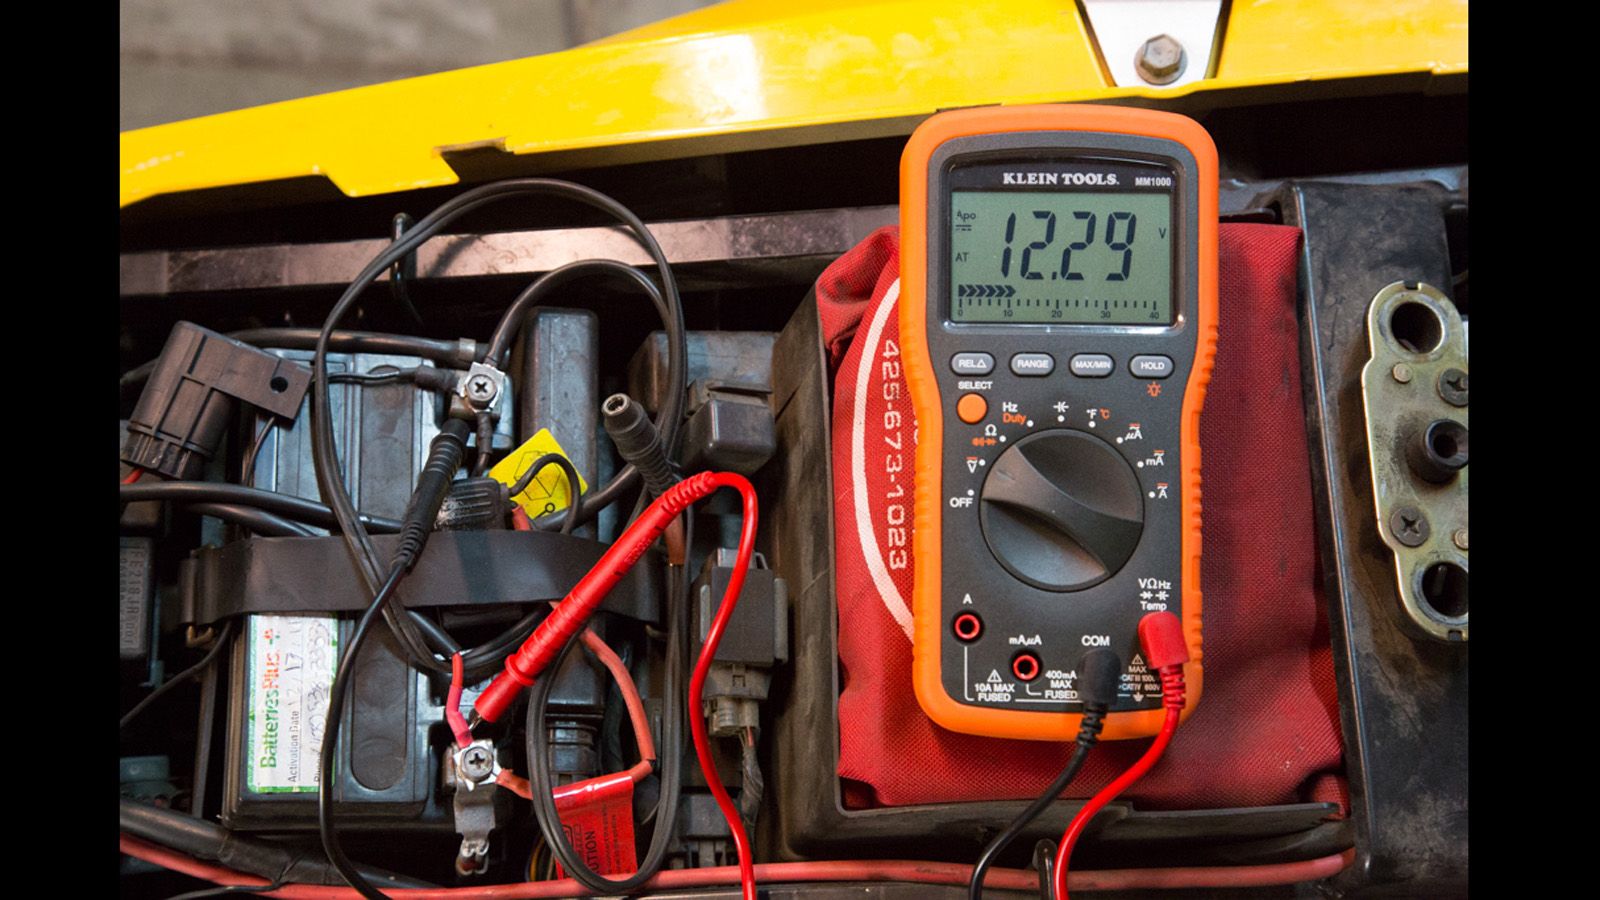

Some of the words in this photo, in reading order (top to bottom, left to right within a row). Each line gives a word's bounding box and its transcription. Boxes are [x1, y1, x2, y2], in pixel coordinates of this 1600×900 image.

[1003, 173, 1058, 185] KLEIN
[1135, 177, 1171, 187] MM1000
[1158, 228, 1167, 239] V
[1001, 211, 1137, 281] 12.29
[955, 253, 969, 263] AT
[957, 309, 964, 318] 0
[1003, 309, 1013, 318] 10
[1051, 309, 1062, 319] 20
[1101, 310, 1111, 319] 30
[1149, 310, 1159, 319] 40
[1017, 360, 1049, 369] RANGE
[1075, 361, 1111, 369] MAX/MIN
[1141, 362, 1165, 370] HOLD
[958, 381, 993, 390] SELECT
[1002, 402, 1018, 412] Hz
[1003, 413, 1027, 425] Duty
[882, 339, 907, 570] 425-673-1023
[950, 497, 974, 508] OFF
[963, 593, 973, 604] A
[1140, 601, 1167, 612] Temp
[1081, 635, 1110, 646] COM
[1045, 670, 1077, 679] 400mA
[974, 683, 992, 693] 10A
[993, 683, 1015, 693] MAX
[1050, 679, 1072, 688] MAX
[978, 693, 1011, 702] FUSED
[1044, 690, 1078, 699] FUSED
[288, 711, 300, 733] Date
[287, 735, 299, 783] Activation
